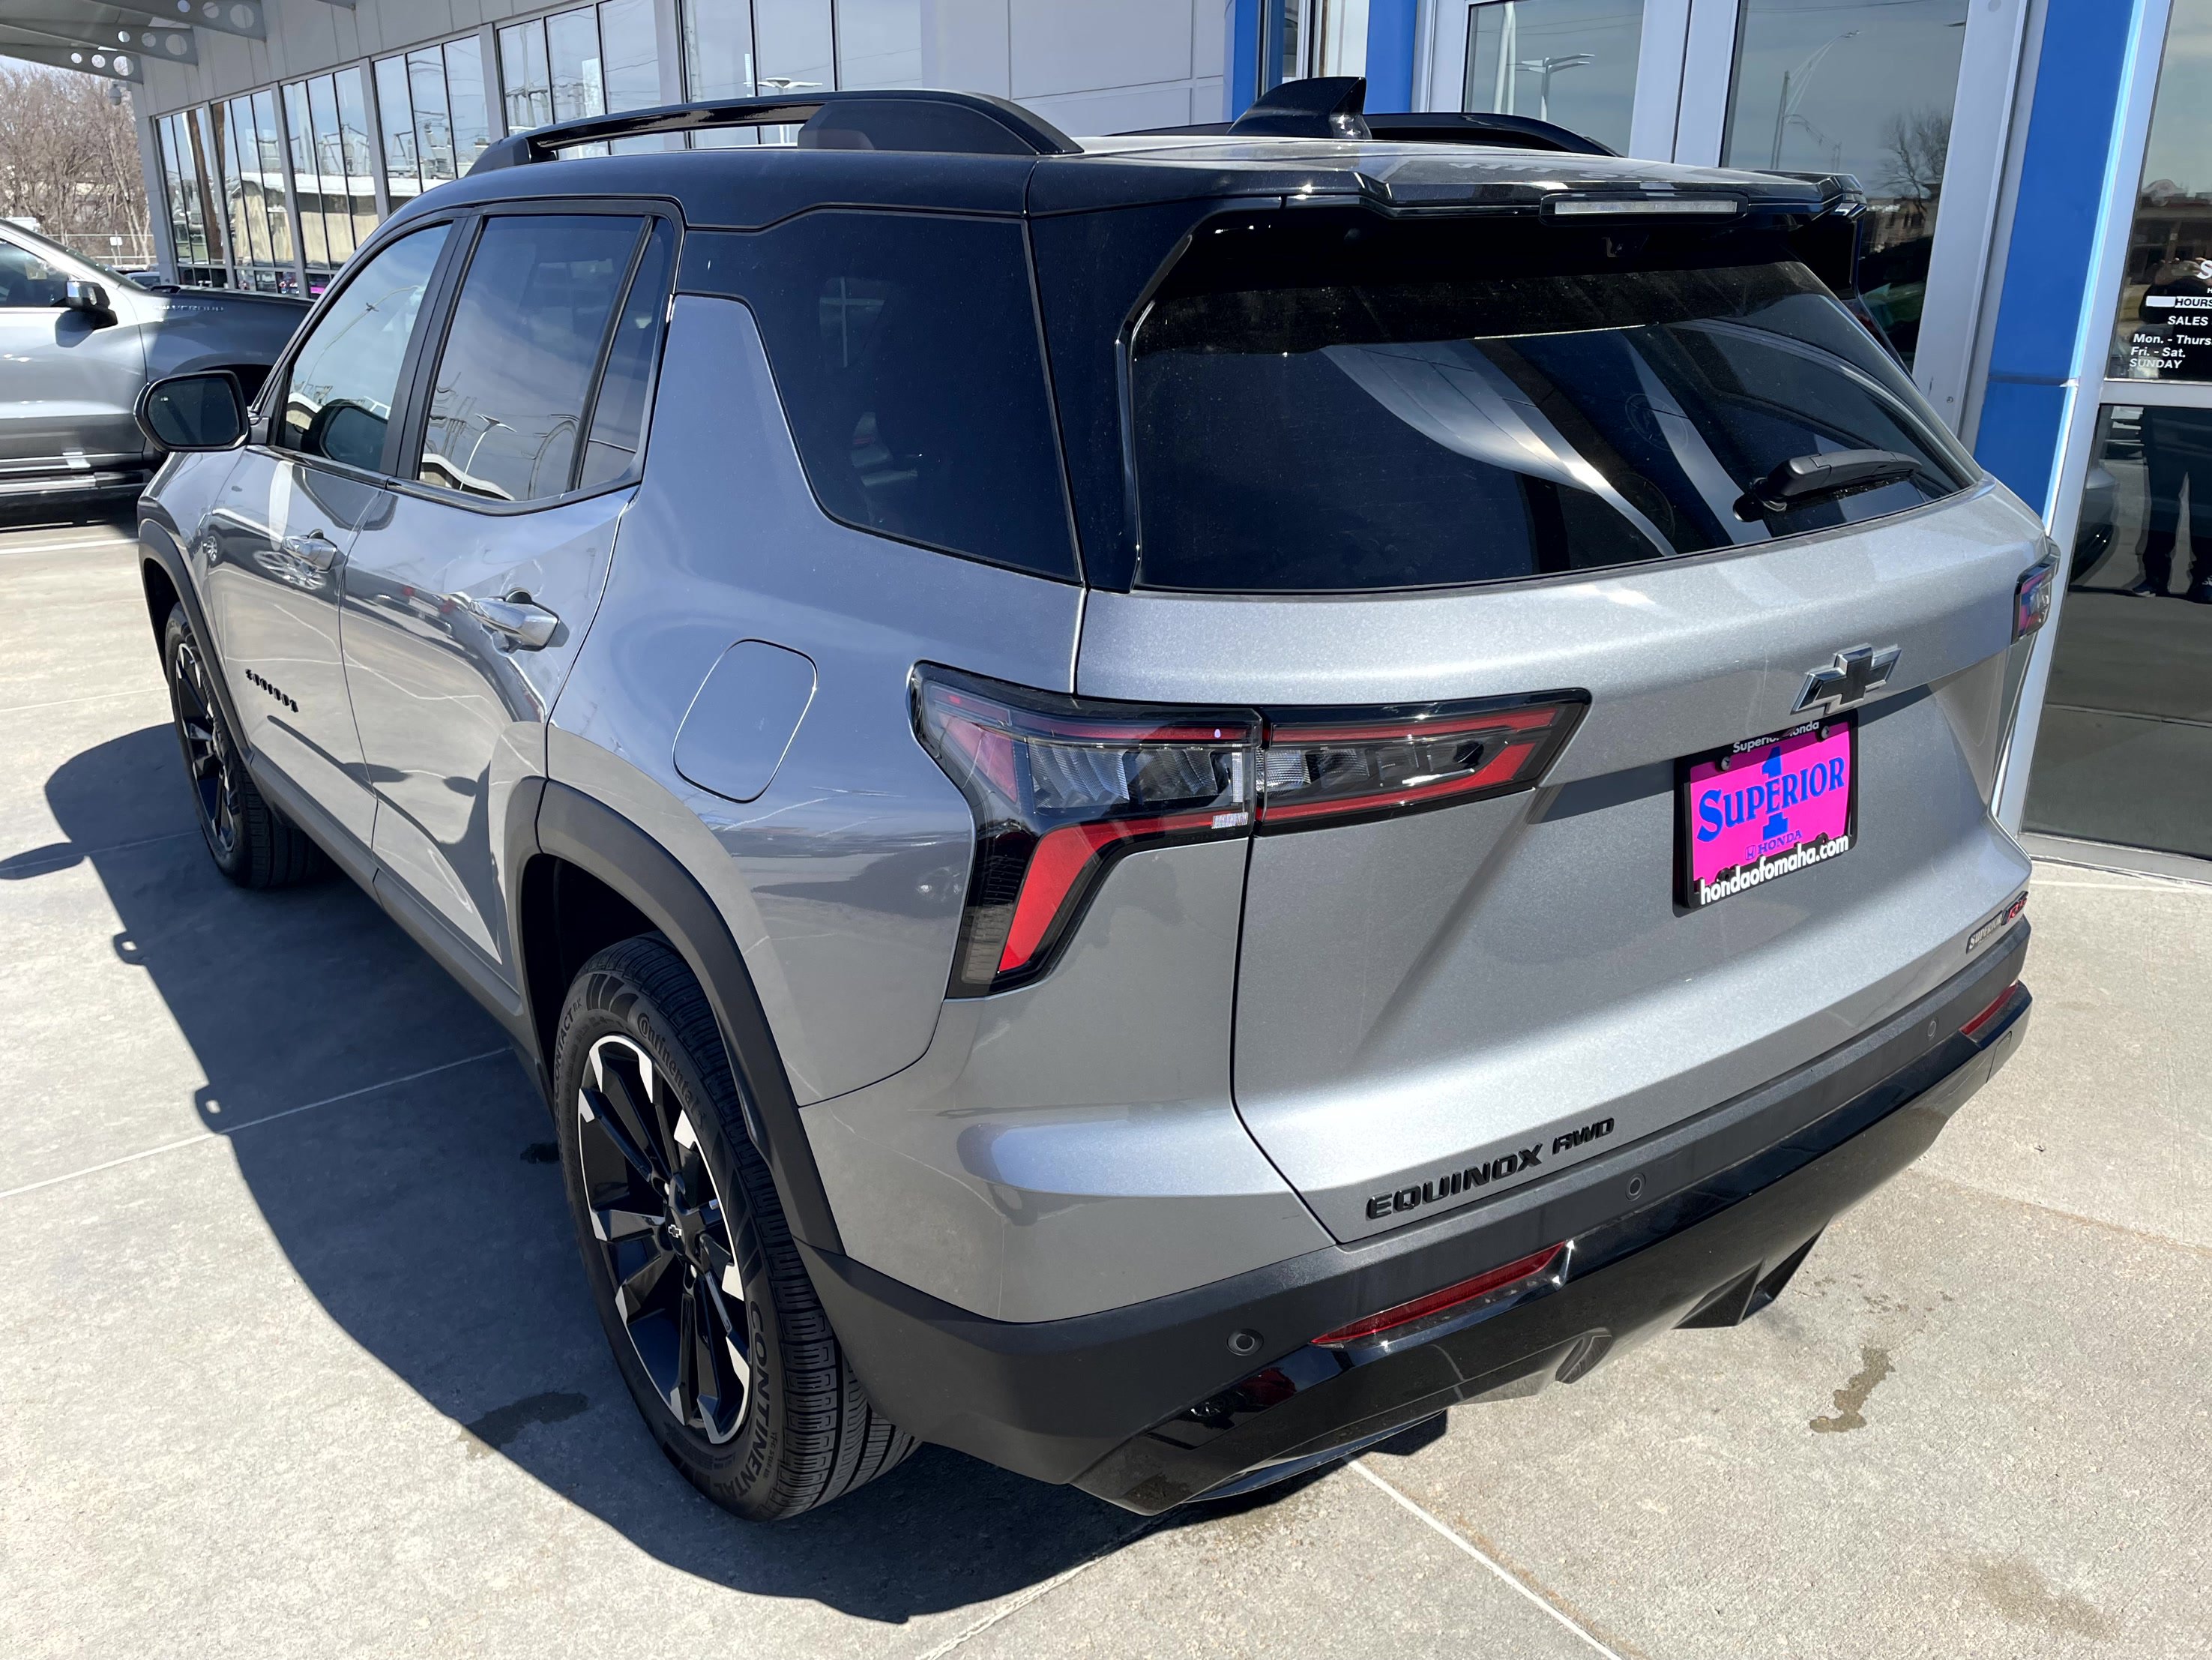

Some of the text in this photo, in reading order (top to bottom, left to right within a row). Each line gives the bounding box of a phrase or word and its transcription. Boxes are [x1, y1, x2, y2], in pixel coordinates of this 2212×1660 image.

[2175, 298, 2212, 307] HOURS
[2168, 316, 2209, 326] SALES
[2133, 334, 2164, 343] Mon.
[2129, 358, 2183, 369] SUNDAY
[2131, 346, 2151, 356] Fri.
[2162, 347, 2186, 358] Sat.
[1696, 757, 1845, 842] SUPERIOR
[1758, 829, 1803, 855] HONDA
[1700, 834, 1849, 905] hondaofomaha.com
[636, 1011, 701, 1116] Continental
[1366, 1117, 1615, 1219] EQUINOX AWD
[713, 1299, 771, 1500] CONTINENTAL
